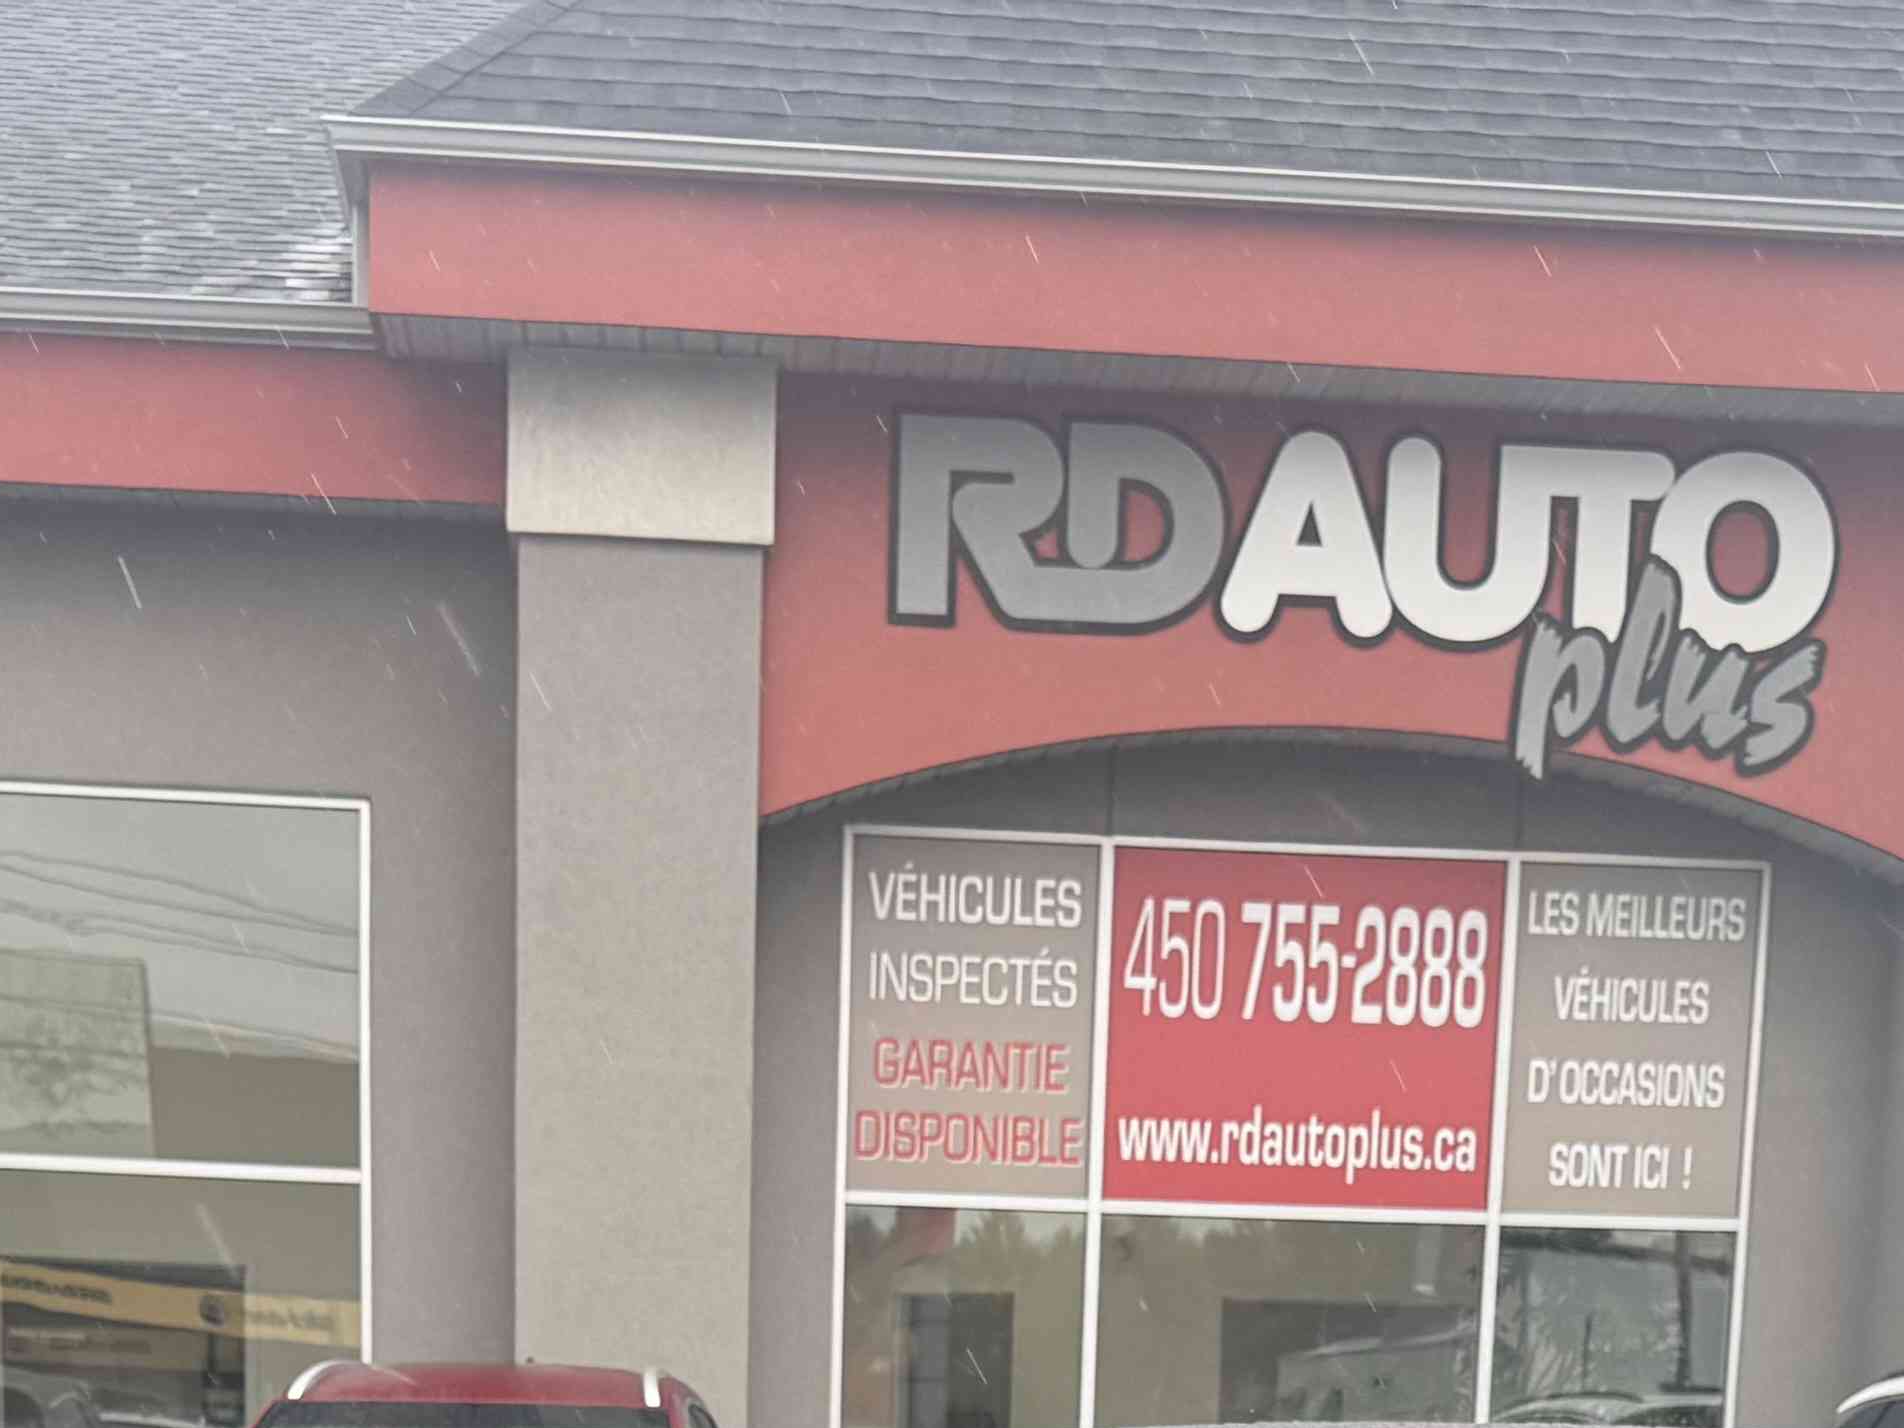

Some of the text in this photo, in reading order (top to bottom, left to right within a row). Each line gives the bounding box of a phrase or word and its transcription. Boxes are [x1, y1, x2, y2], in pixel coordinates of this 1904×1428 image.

[1512, 558, 1820, 782] plus
[867, 861, 1083, 929] VÉHICULES
[1526, 890, 1746, 942] LES MEILLEURS
[868, 947, 1079, 1009] INSPECTÉS
[1122, 896, 1490, 1029] 450 755-2888
[1554, 964, 1710, 1025] VÉHICULES
[873, 1036, 1073, 1096] GARANTIE
[854, 1108, 1086, 1169] DISPONIBLE
[1117, 1104, 1479, 1185] www.rdautoplus.ca
[1548, 1142, 1629, 1190] SONT
[1633, 1145, 1670, 1190] ICI
